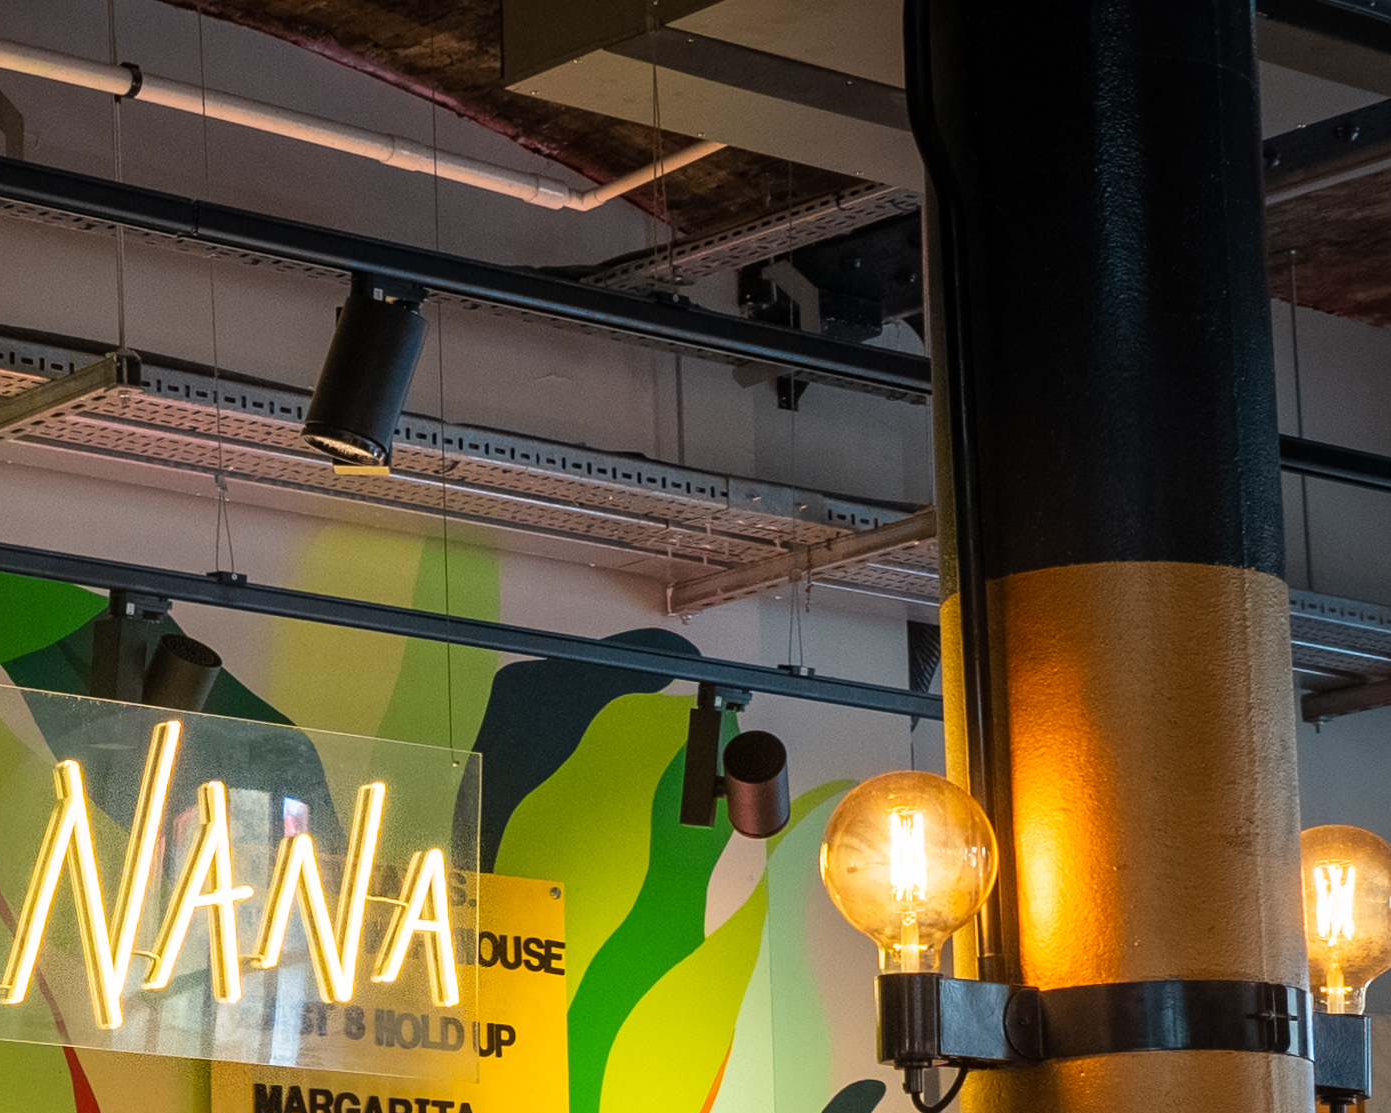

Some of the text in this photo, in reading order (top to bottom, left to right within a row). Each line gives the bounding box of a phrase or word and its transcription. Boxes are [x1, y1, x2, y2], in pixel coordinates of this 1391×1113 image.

[2, 718, 460, 1030] NANA
[373, 1009, 465, 1052] HOLD
[473, 1022, 516, 1058] UP
